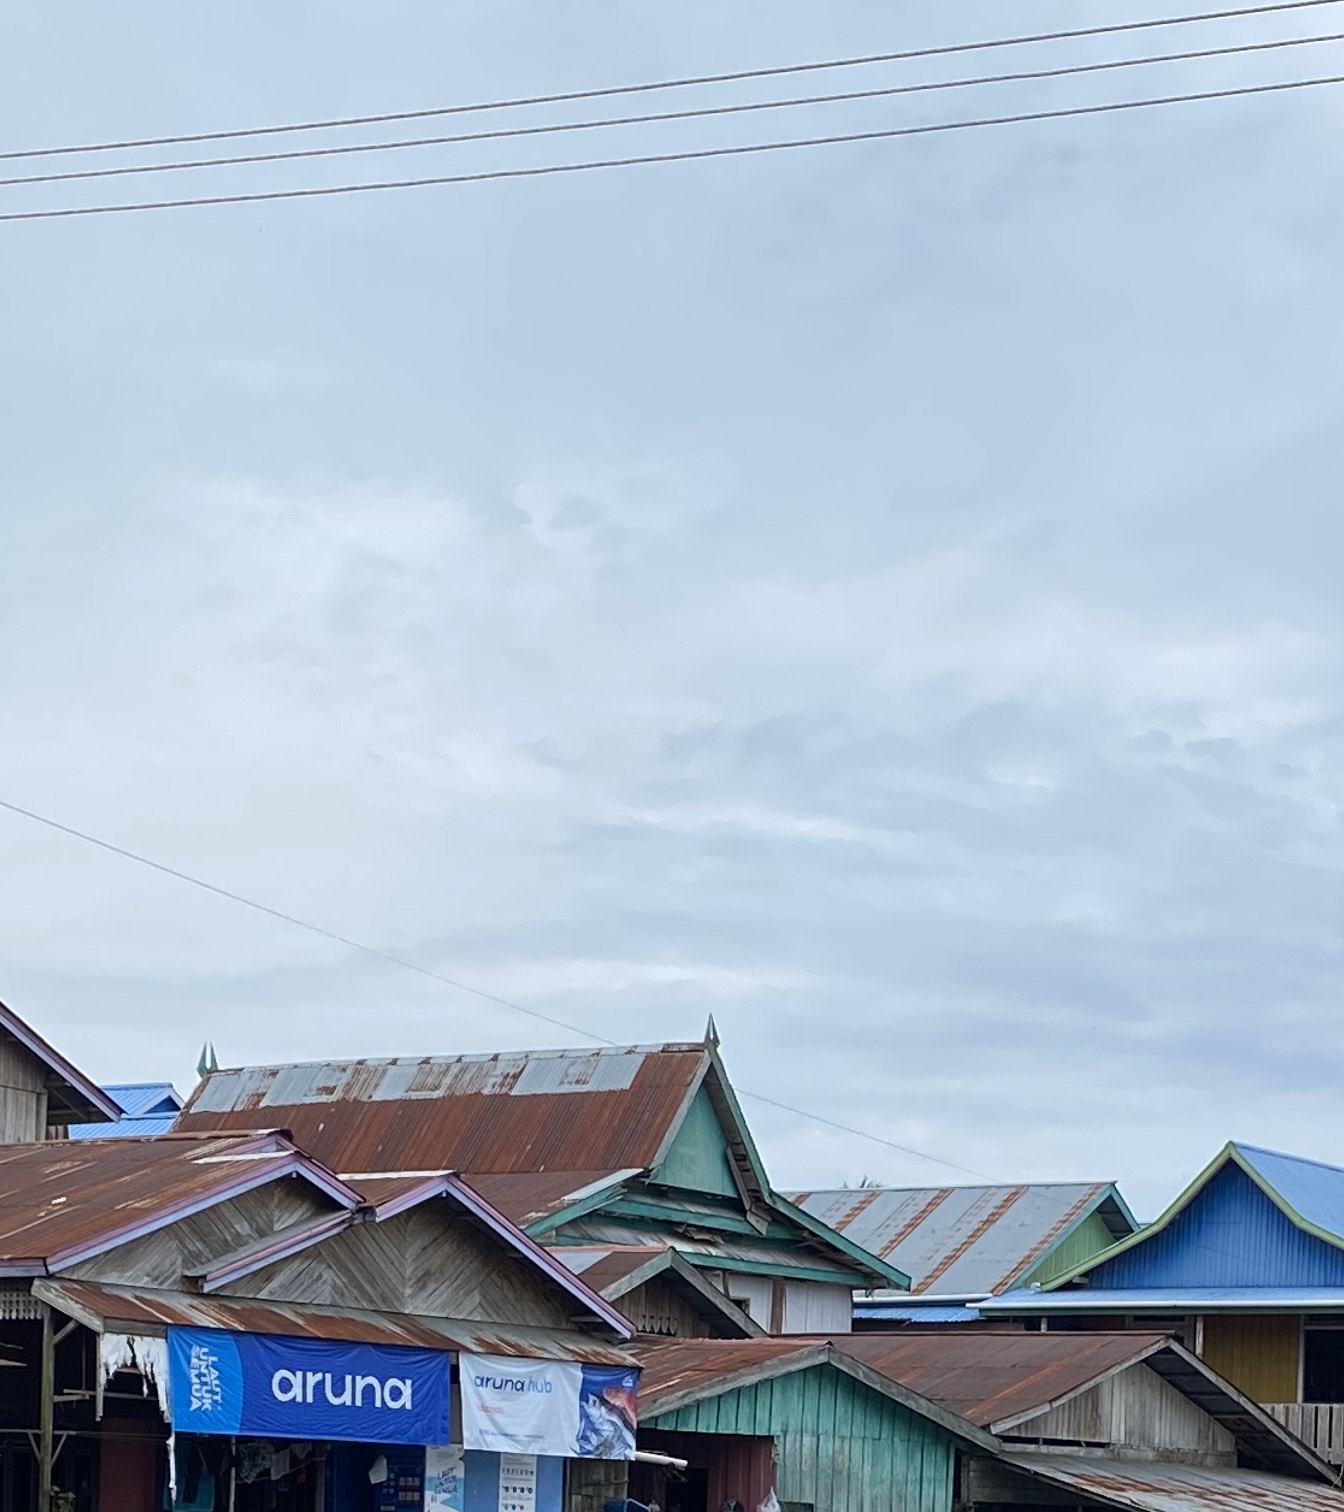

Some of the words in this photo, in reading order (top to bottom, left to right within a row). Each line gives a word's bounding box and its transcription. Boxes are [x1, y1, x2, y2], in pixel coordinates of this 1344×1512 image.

[271, 1368, 413, 1410] aruna
[474, 1375, 524, 1392] aruna
[528, 1379, 553, 1394] hub
